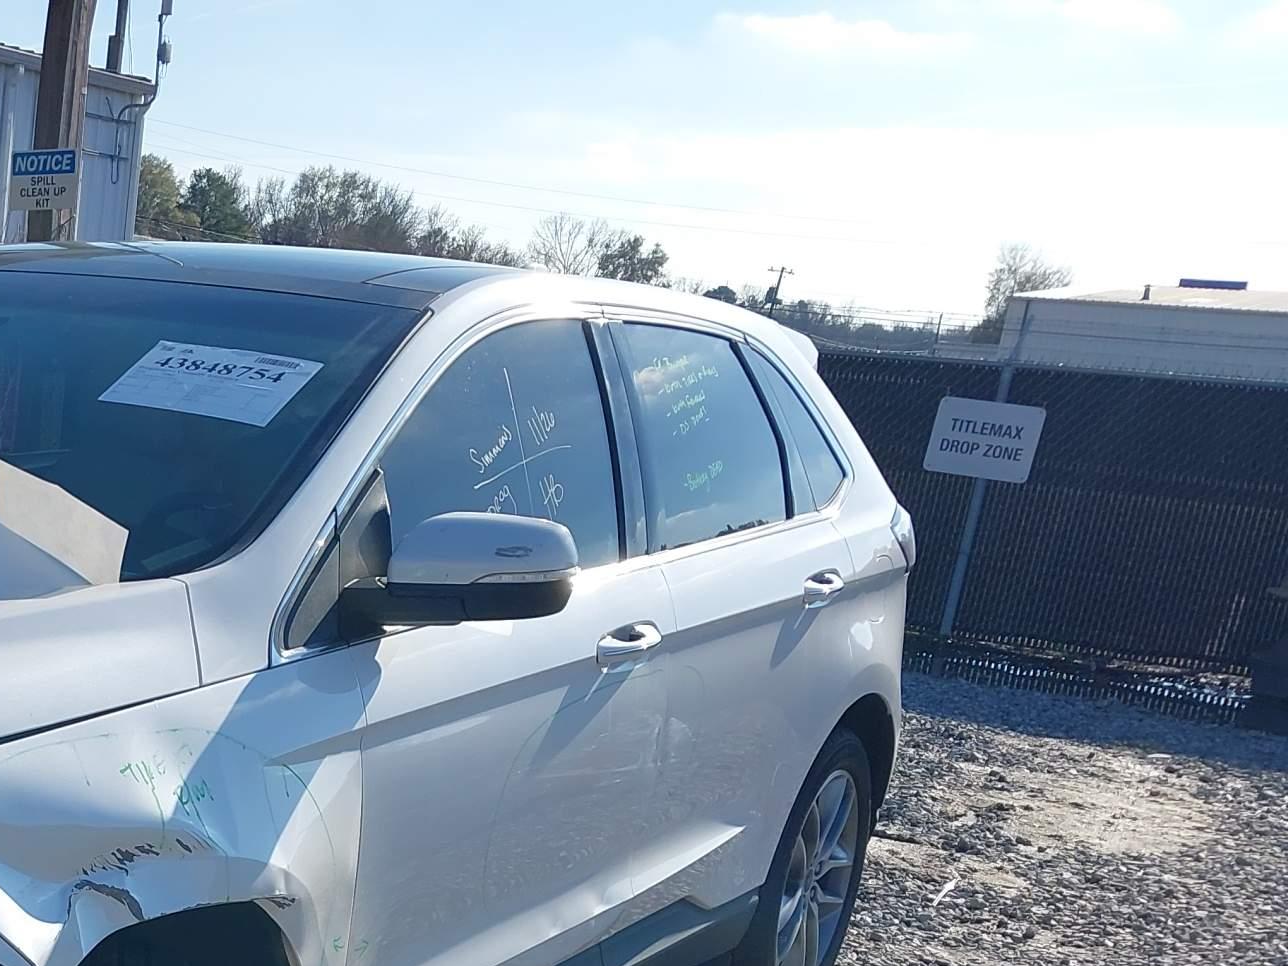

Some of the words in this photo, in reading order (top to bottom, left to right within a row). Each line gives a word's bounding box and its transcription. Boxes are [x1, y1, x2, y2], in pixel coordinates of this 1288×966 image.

[15, 154, 73, 172] NOTICE
[30, 175, 57, 186] SPILL
[19, 187, 50, 198] CLEAN
[53, 186, 67, 197] UP
[35, 198, 50, 208] KIT
[154, 356, 287, 383] 43848754
[951, 418, 1025, 440] TITLEMAX
[939, 438, 980, 456] DROP
[982, 443, 1024, 461] ZONE
